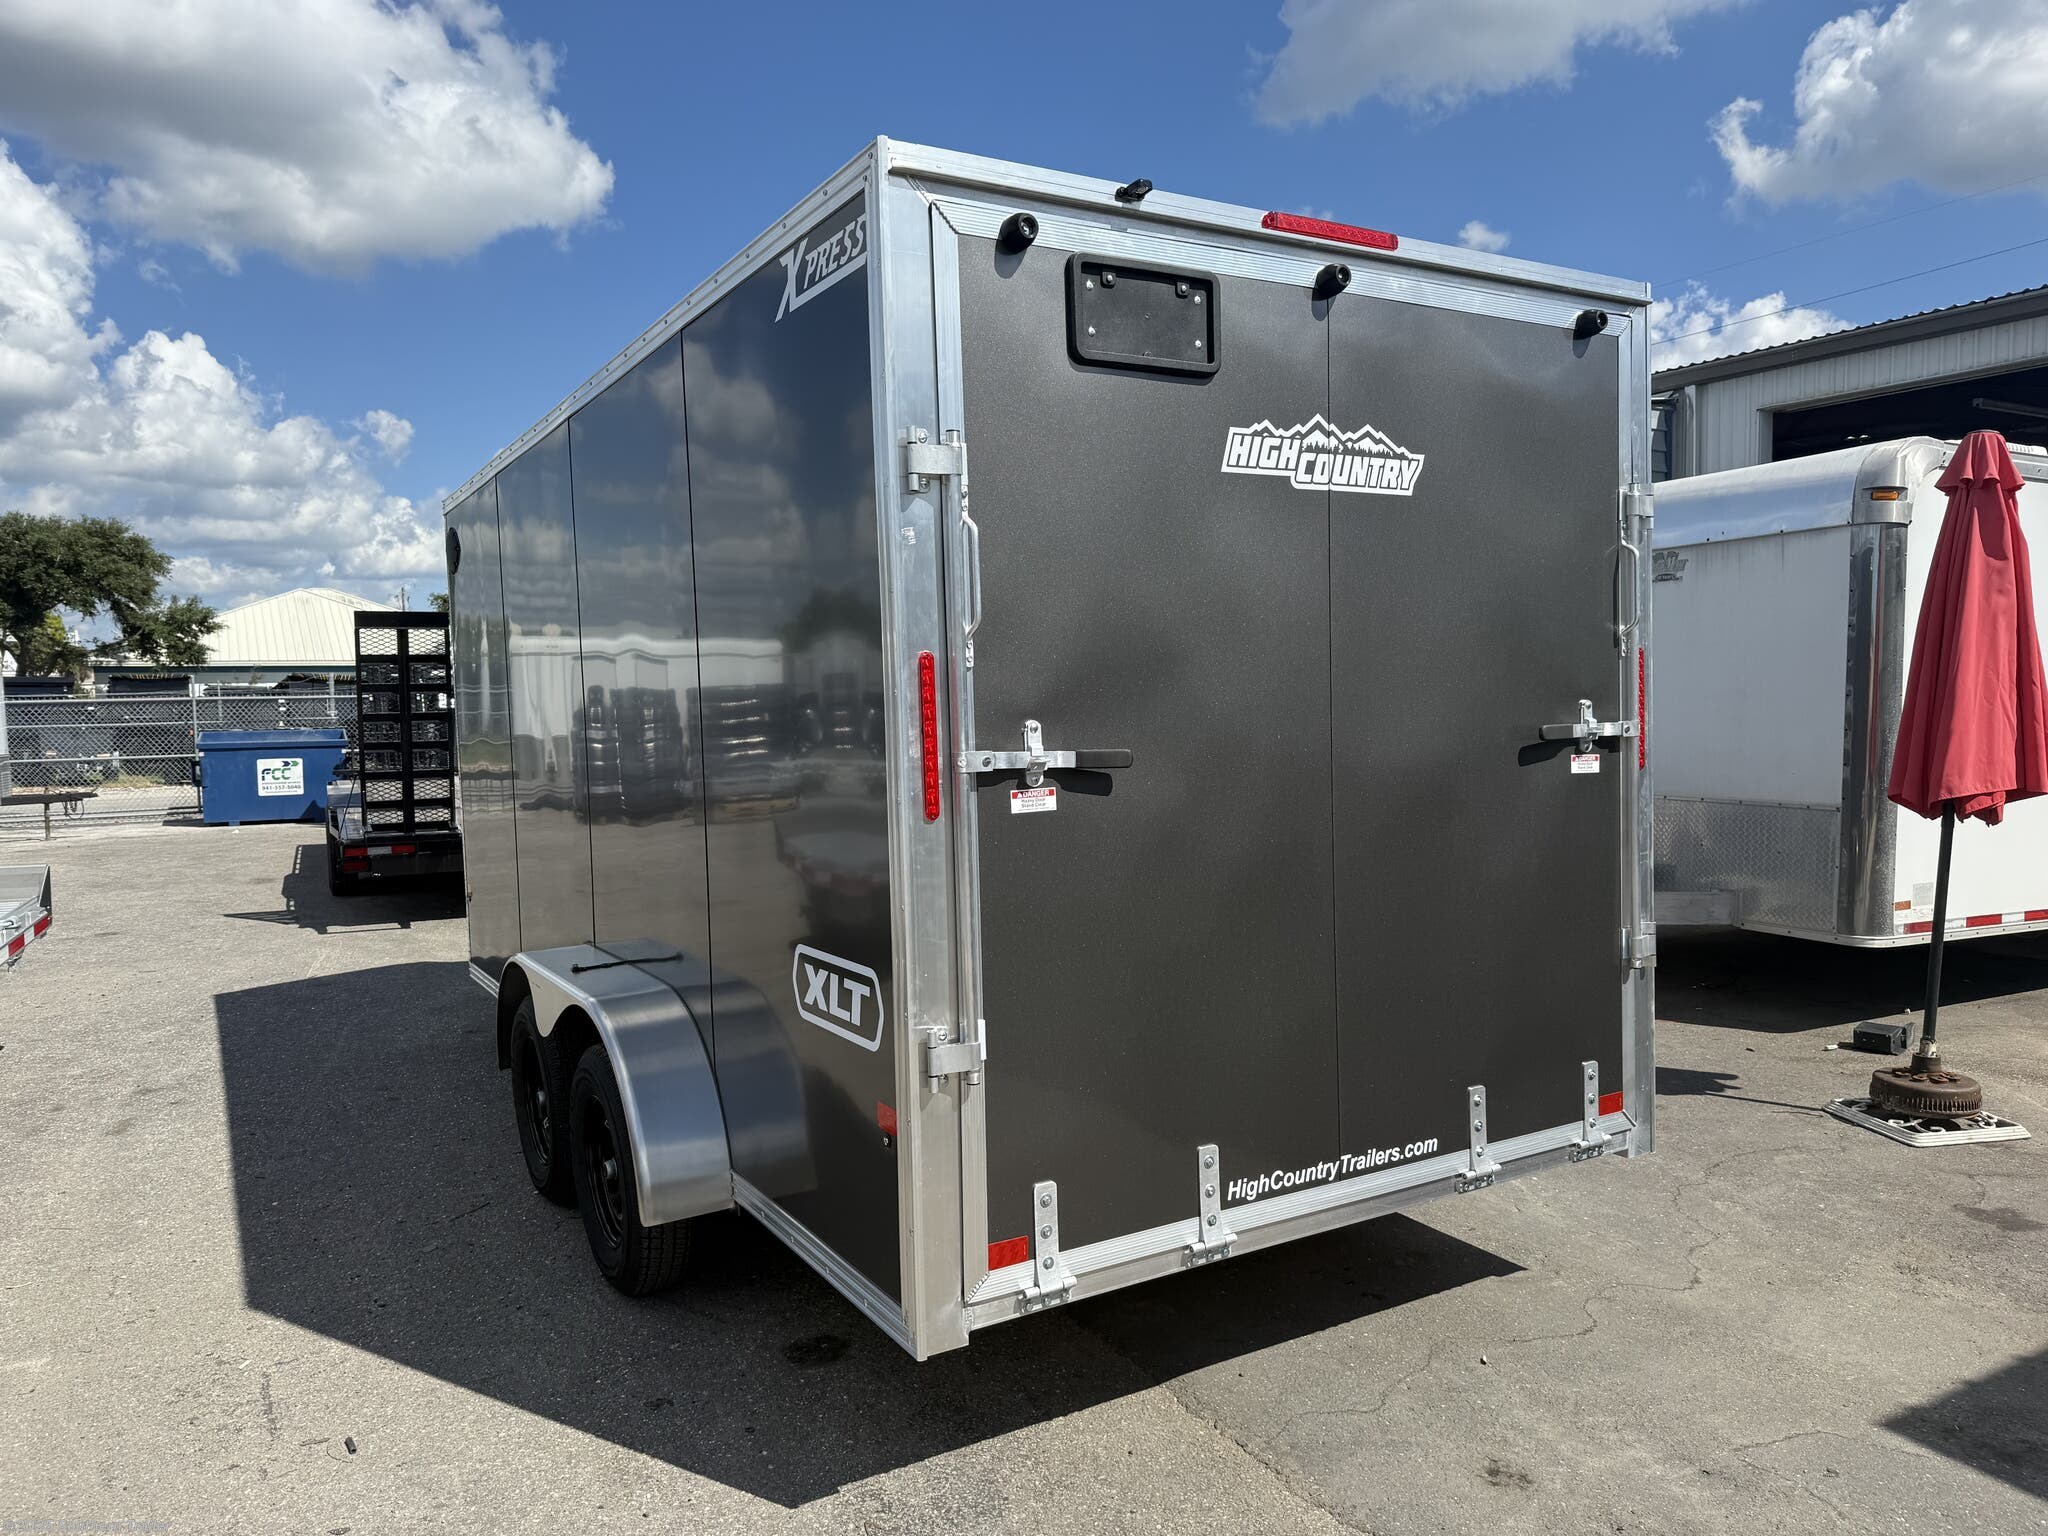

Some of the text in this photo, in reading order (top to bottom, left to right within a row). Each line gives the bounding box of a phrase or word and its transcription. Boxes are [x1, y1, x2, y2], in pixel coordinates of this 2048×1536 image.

[775, 213, 868, 323] XPRESS
[1227, 433, 1420, 490] HIGH COUNTRY
[261, 767, 291, 781] FCC
[1023, 789, 1050, 798] DANGER
[804, 962, 871, 1027] XLT
[1227, 1137, 1438, 1201] HighCountryTrailers.com
